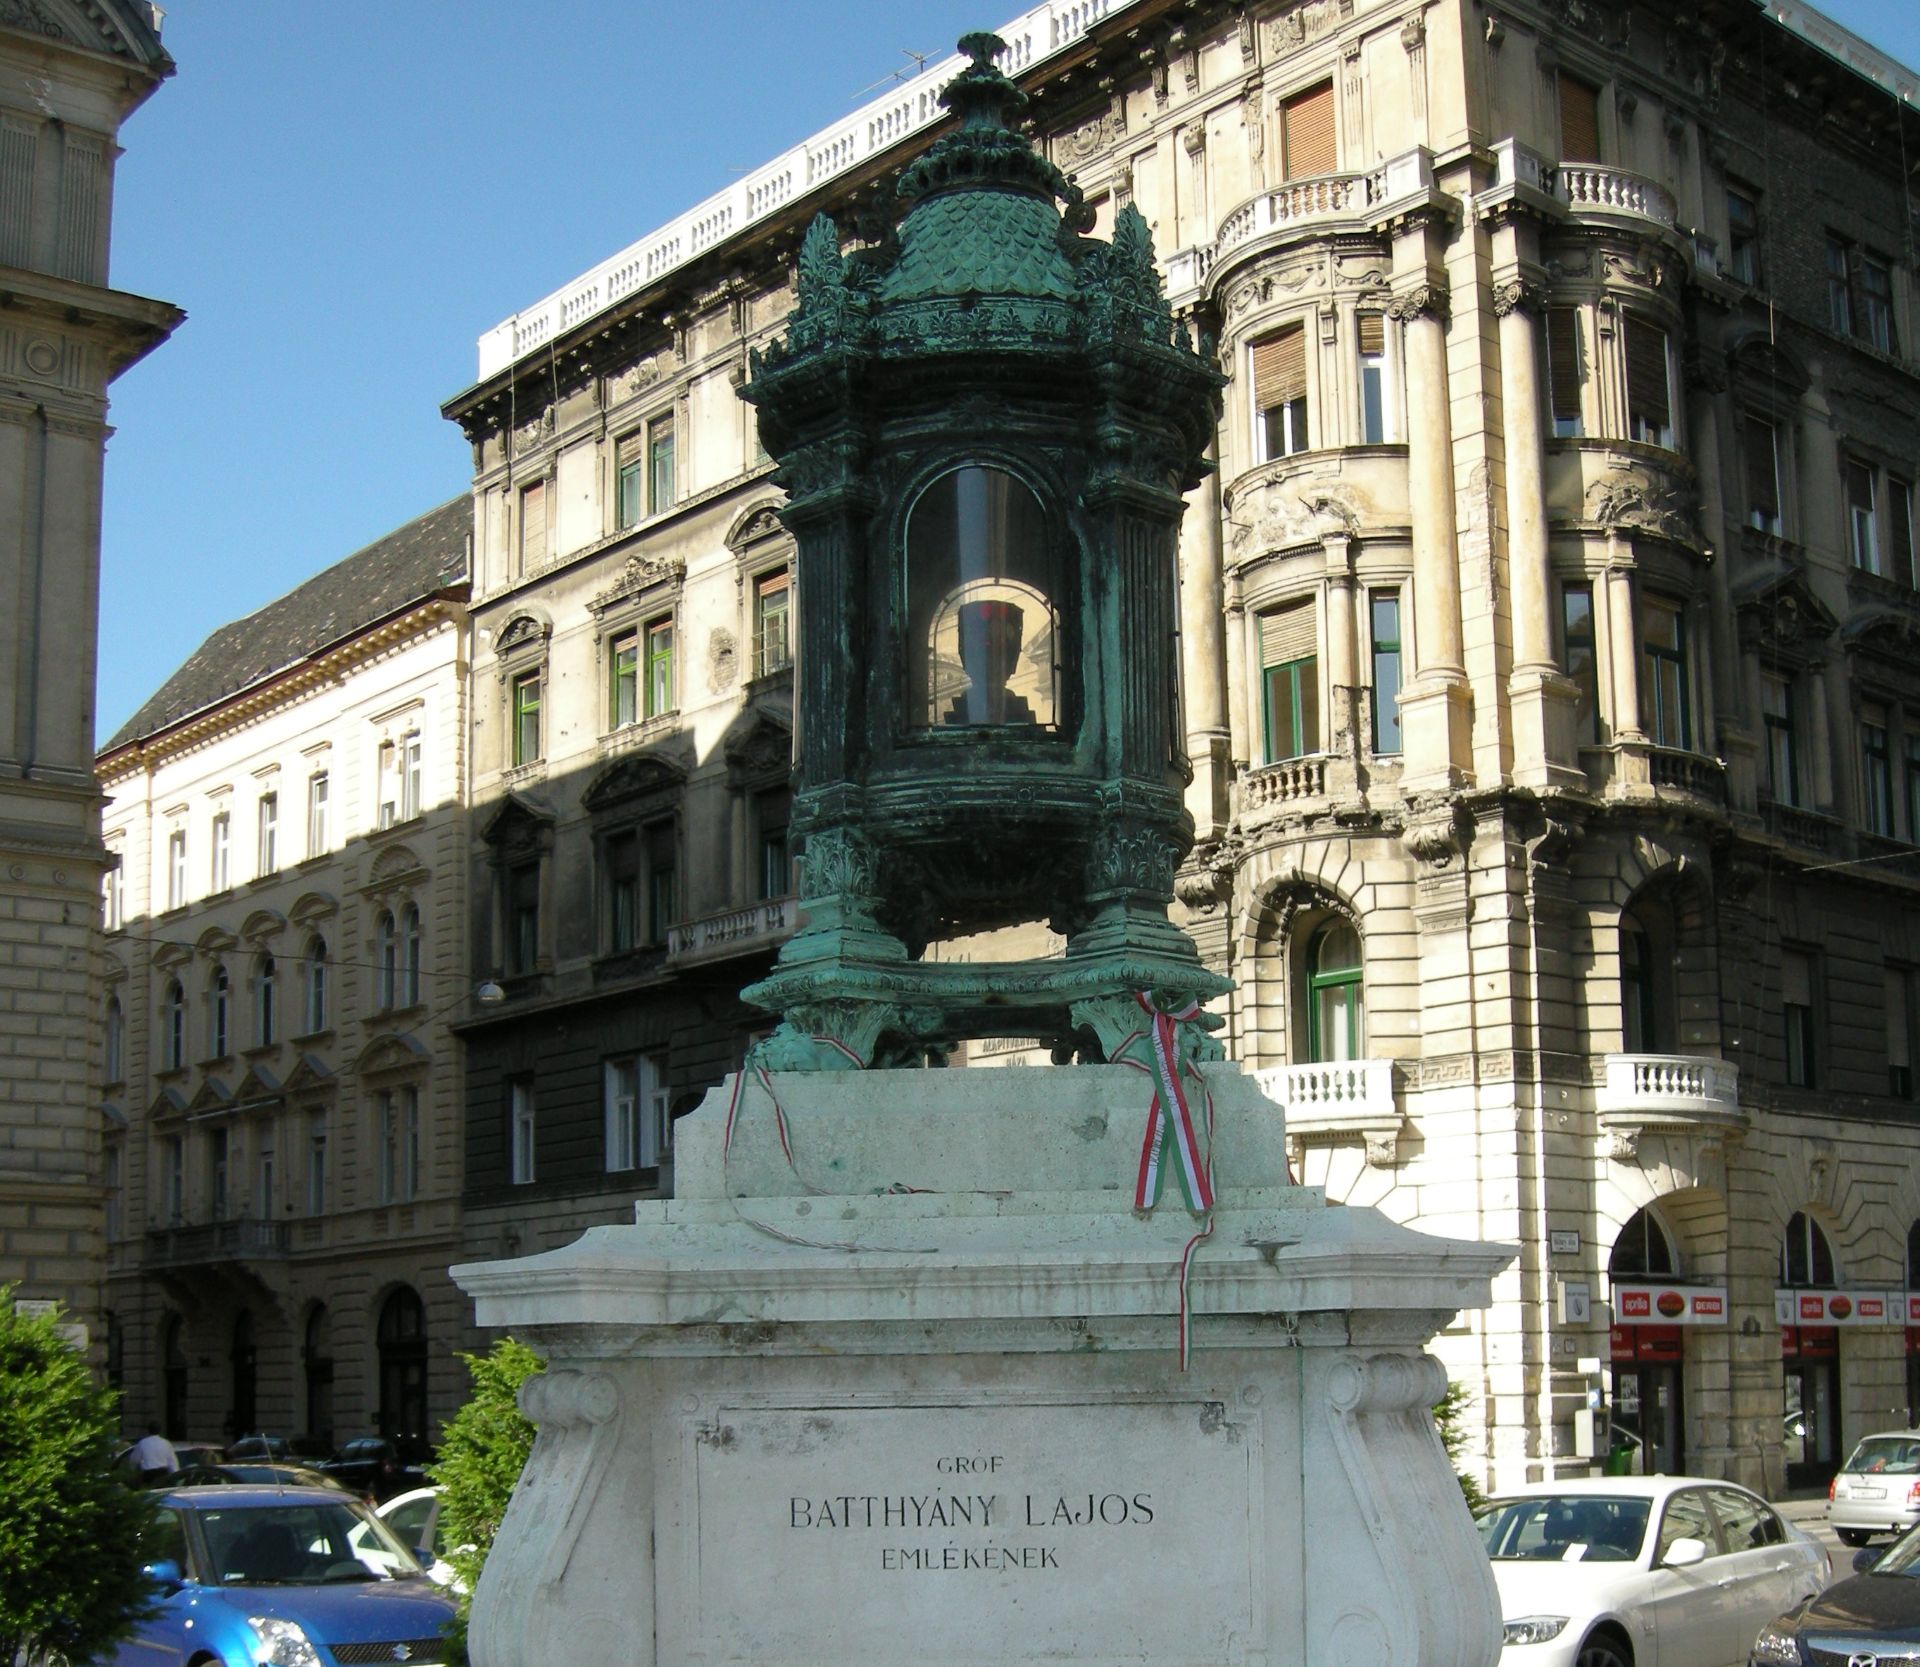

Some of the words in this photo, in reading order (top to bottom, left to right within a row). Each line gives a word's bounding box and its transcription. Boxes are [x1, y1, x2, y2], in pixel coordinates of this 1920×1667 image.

[937, 1449, 1005, 1474] GRÓF
[789, 1487, 997, 1528] BATTHYÁNY
[1025, 1493, 1154, 1526] LAJOS
[882, 1540, 1060, 1571] EMLÉKÉNEK
